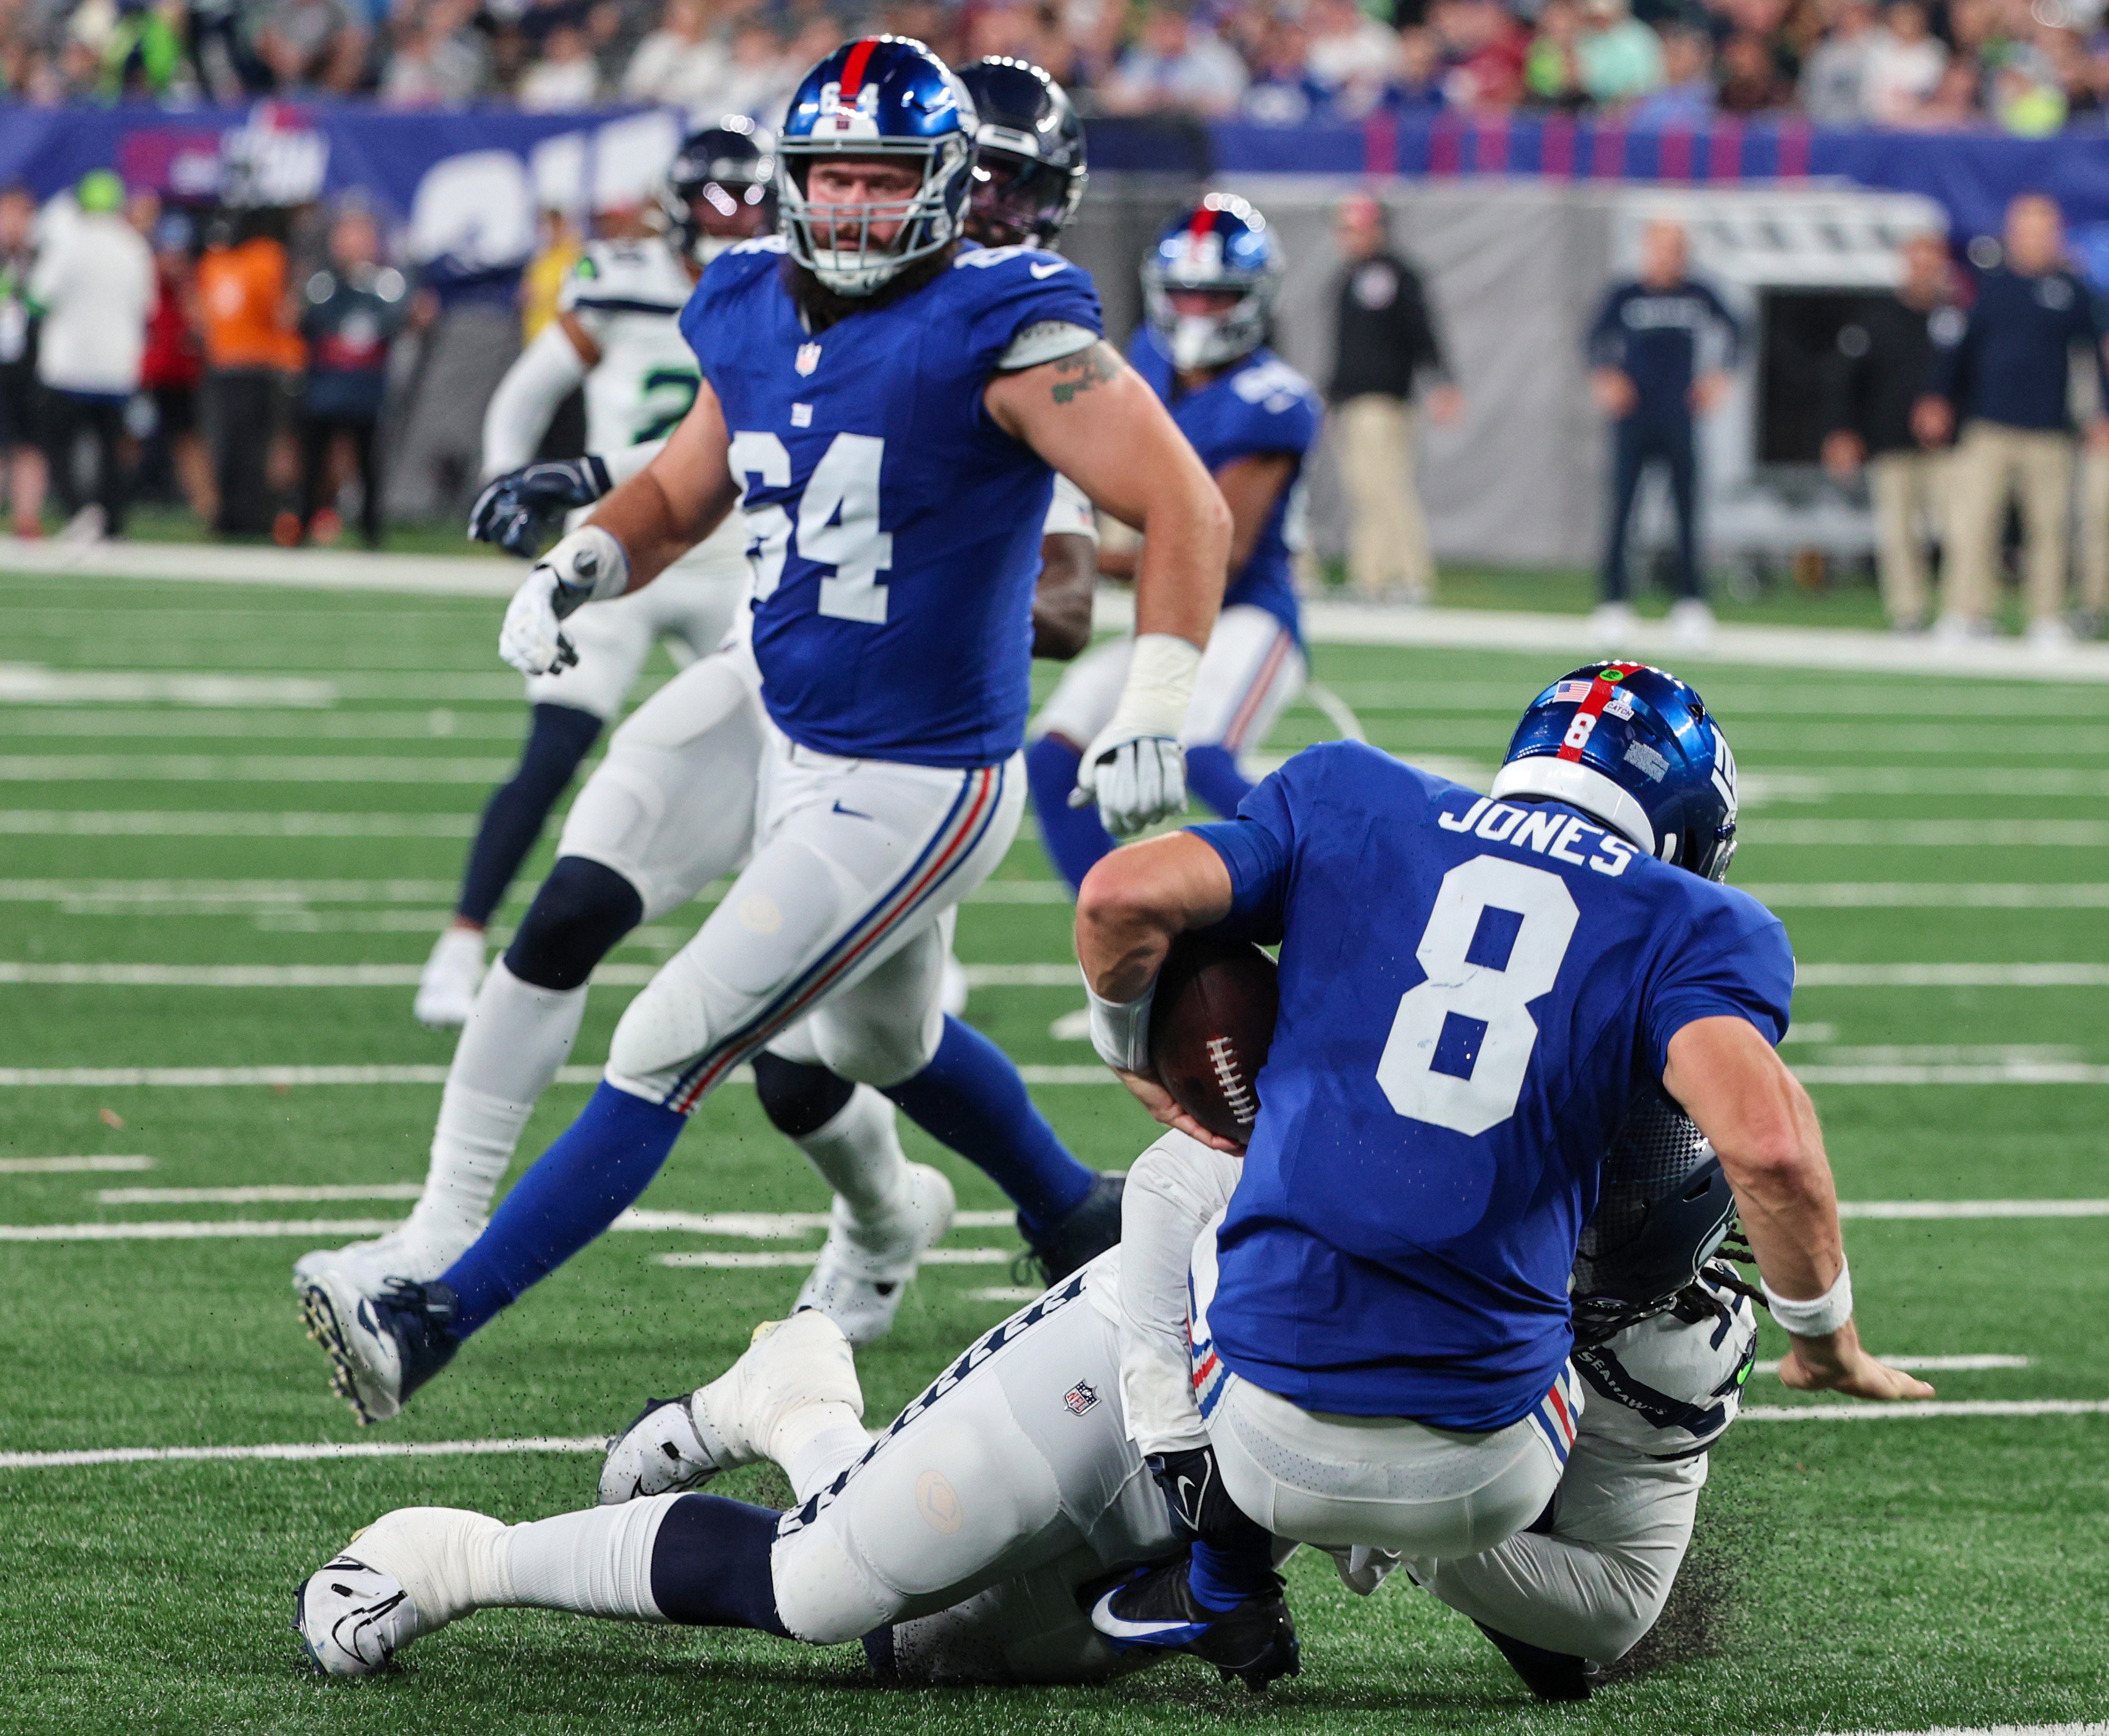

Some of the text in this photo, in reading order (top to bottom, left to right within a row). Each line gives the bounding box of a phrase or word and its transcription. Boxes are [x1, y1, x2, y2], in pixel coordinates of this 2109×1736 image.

[820, 81, 879, 117] 64
[727, 430, 893, 624] 64
[1564, 713, 1597, 749] 8
[1438, 796, 1639, 877] JONES
[1376, 854, 1580, 1137] 8
[1067, 1392, 1087, 1411] NFL
